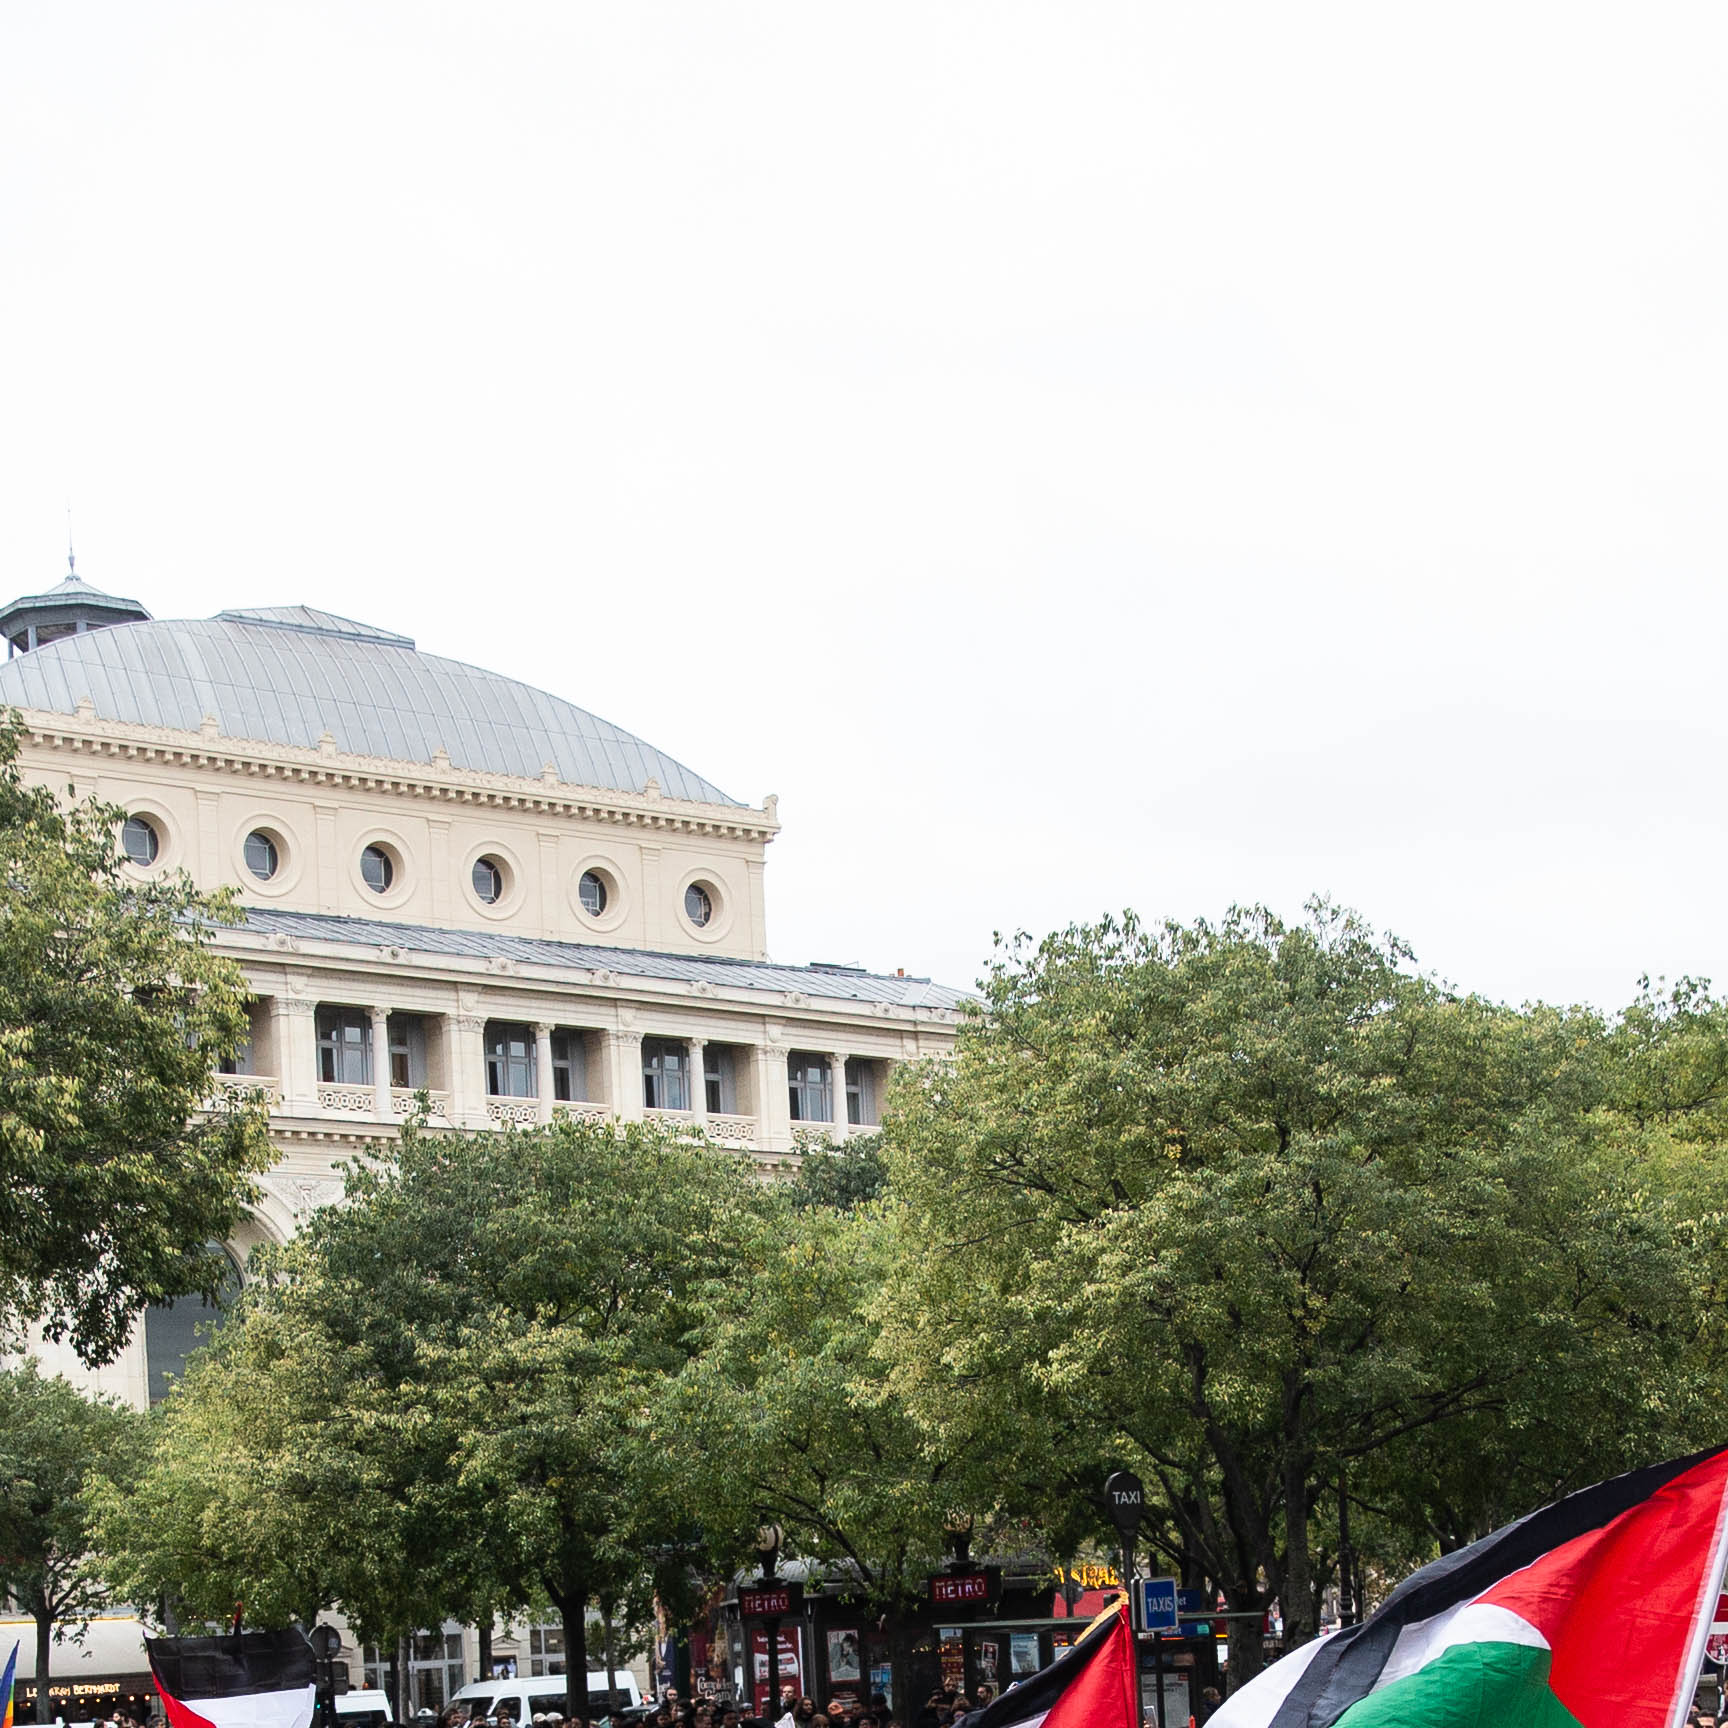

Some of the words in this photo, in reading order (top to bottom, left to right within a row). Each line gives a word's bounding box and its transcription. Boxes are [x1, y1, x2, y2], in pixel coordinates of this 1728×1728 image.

[1112, 1491, 1141, 1505] TAXI
[934, 1577, 985, 1598] METRO
[743, 1592, 789, 1612] METRO
[1147, 1597, 1173, 1613] TAXIS
[48, 1687, 71, 1697] ARAH
